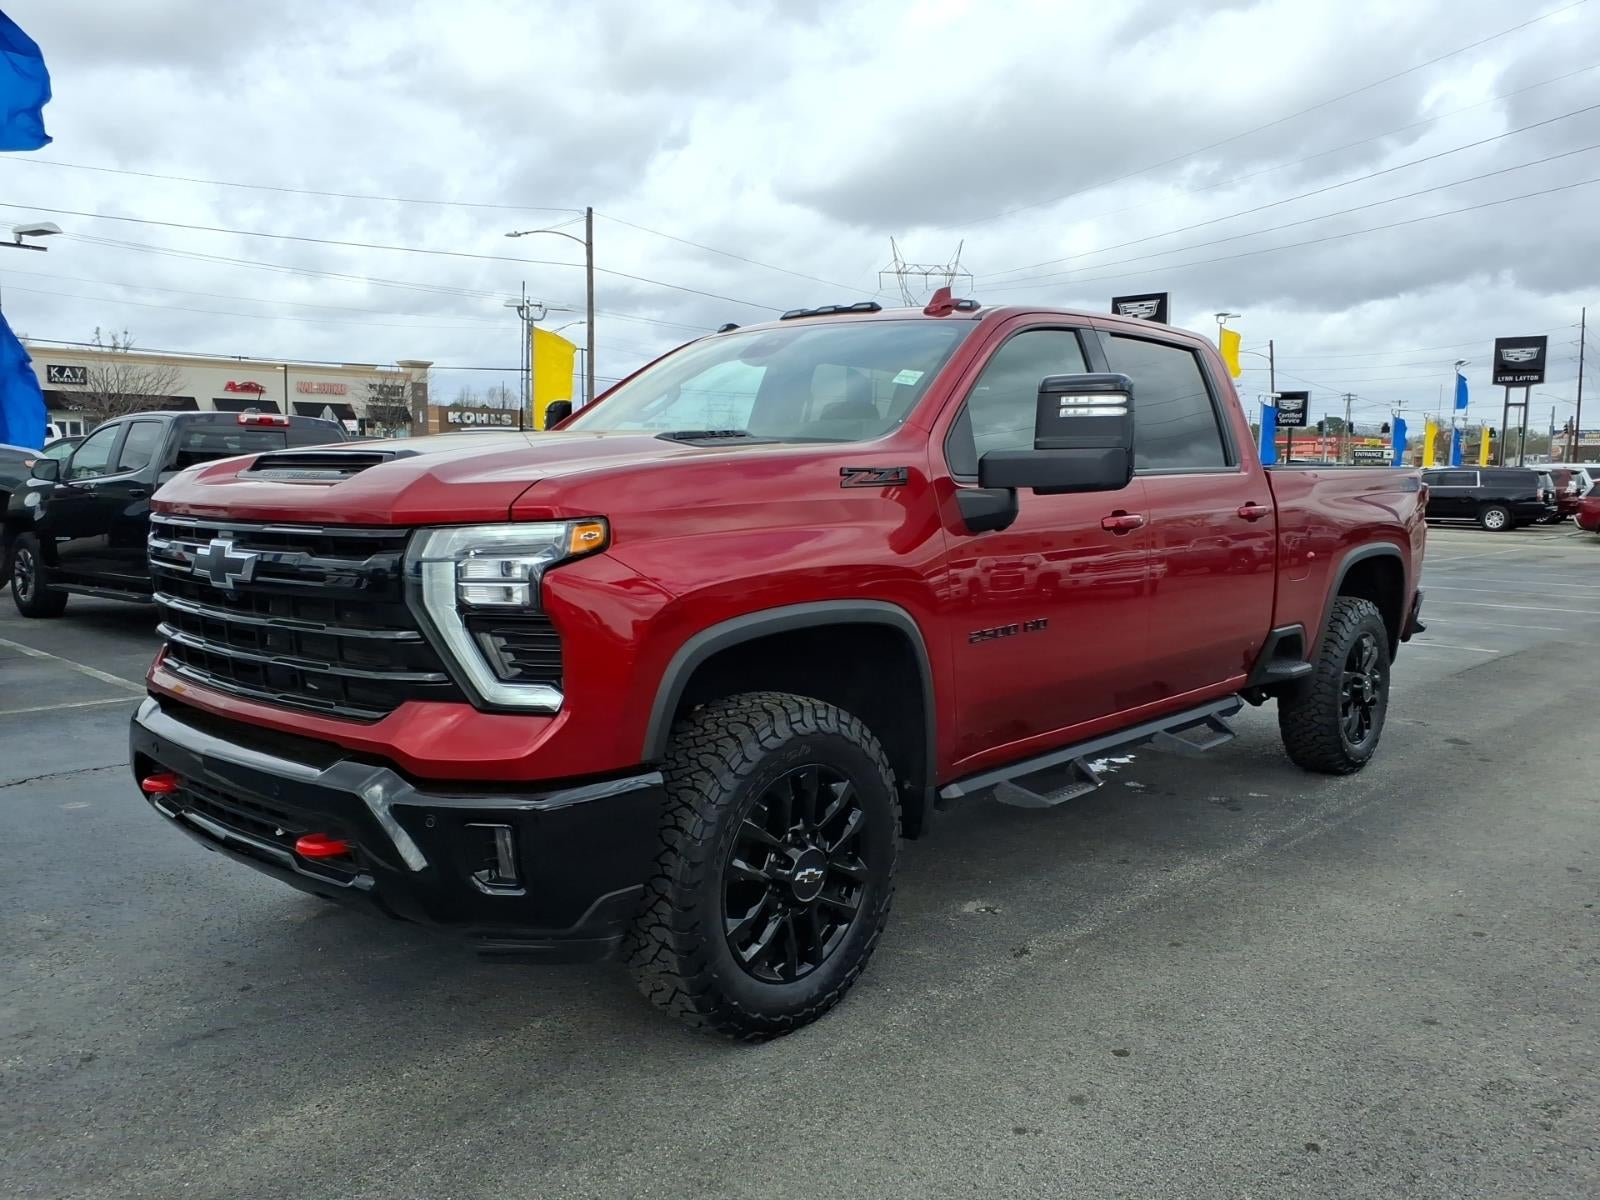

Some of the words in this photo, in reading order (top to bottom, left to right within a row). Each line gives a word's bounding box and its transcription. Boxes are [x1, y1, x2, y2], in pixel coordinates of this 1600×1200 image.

[50, 367, 83, 378] KAY
[447, 411, 512, 425] KOHL'S
[840, 467, 908, 488] Z71
[968, 623, 1019, 645] 2500
[1023, 617, 1048, 632] HD
